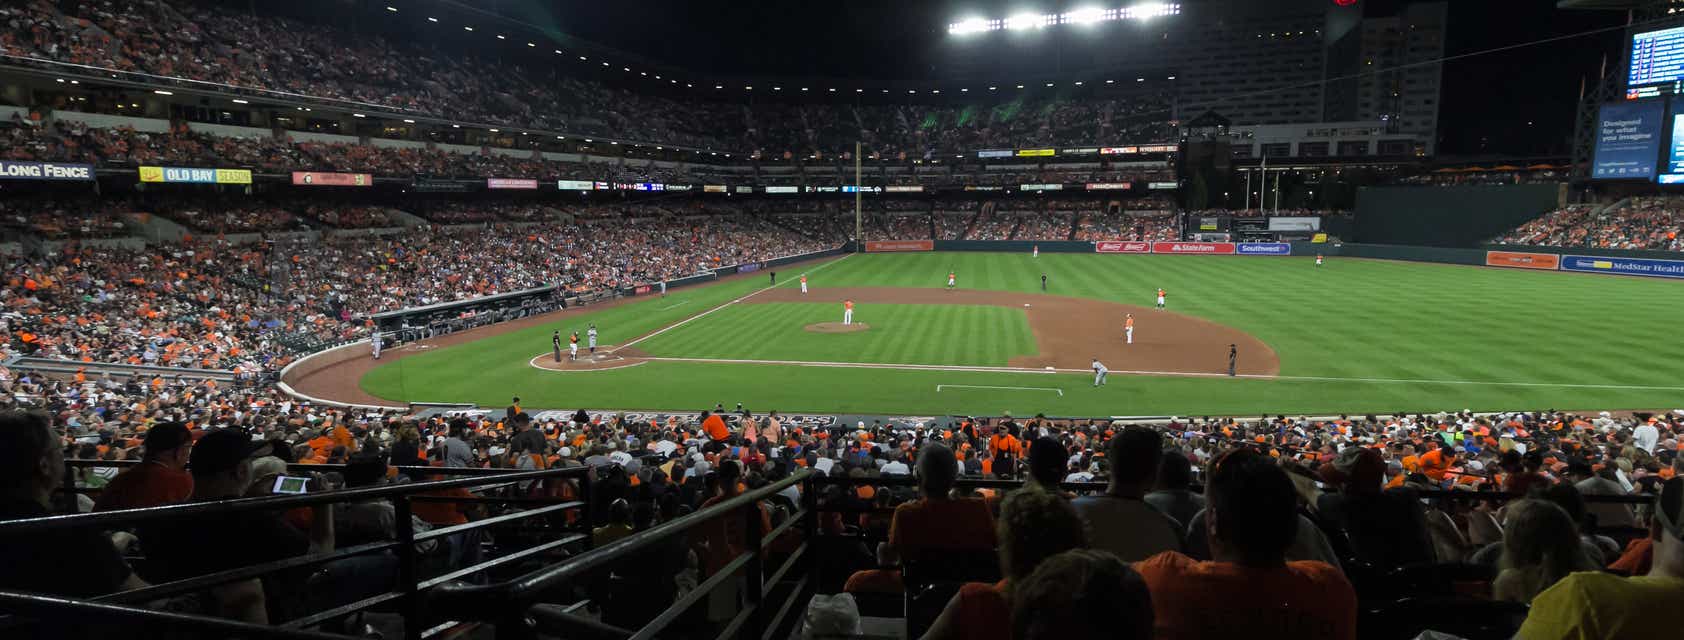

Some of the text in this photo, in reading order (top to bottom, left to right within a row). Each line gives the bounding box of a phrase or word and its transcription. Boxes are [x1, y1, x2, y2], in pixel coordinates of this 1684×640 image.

[0, 162, 89, 178] LONG FENCE
[167, 168, 190, 181] OLD
[192, 169, 213, 181] BAY
[1242, 245, 1280, 253] Southwest
[1613, 262, 1652, 271] MedStar
